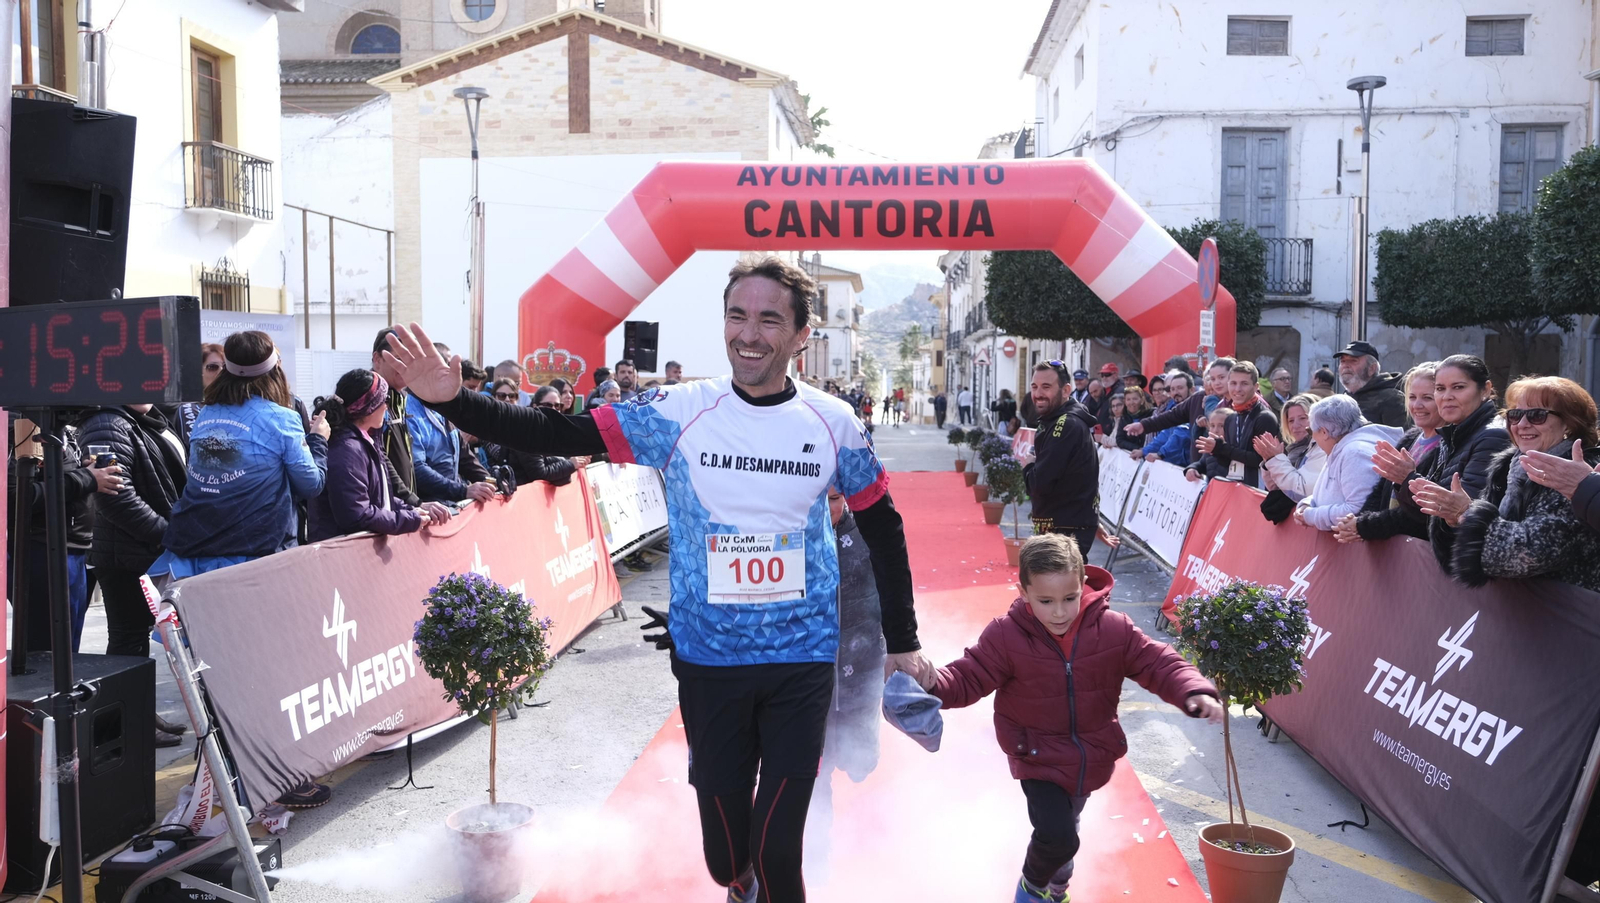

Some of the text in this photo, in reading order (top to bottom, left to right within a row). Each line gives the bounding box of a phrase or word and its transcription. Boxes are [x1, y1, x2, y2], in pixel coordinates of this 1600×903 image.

[737, 165, 1005, 187] AYUNTAMIENTO
[744, 199, 995, 238] CANTORIA
[215, 418, 251, 432] SENDERISTA
[207, 474, 221, 485] La
[221, 469, 247, 484] Rata
[700, 452, 821, 478] C.D.M DESAMPARADOS
[1138, 493, 1187, 542] CANTORIA
[731, 544, 771, 553] PÓLVORA
[733, 535, 755, 544] CxM
[728, 557, 784, 584] 100
[280, 639, 416, 741] TEAMERGY
[1363, 657, 1523, 766] TEAMERGY
[332, 709, 405, 763] www.teamergy.es
[1372, 728, 1453, 791] www.teamergy.es
[200, 782, 211, 799] EL
